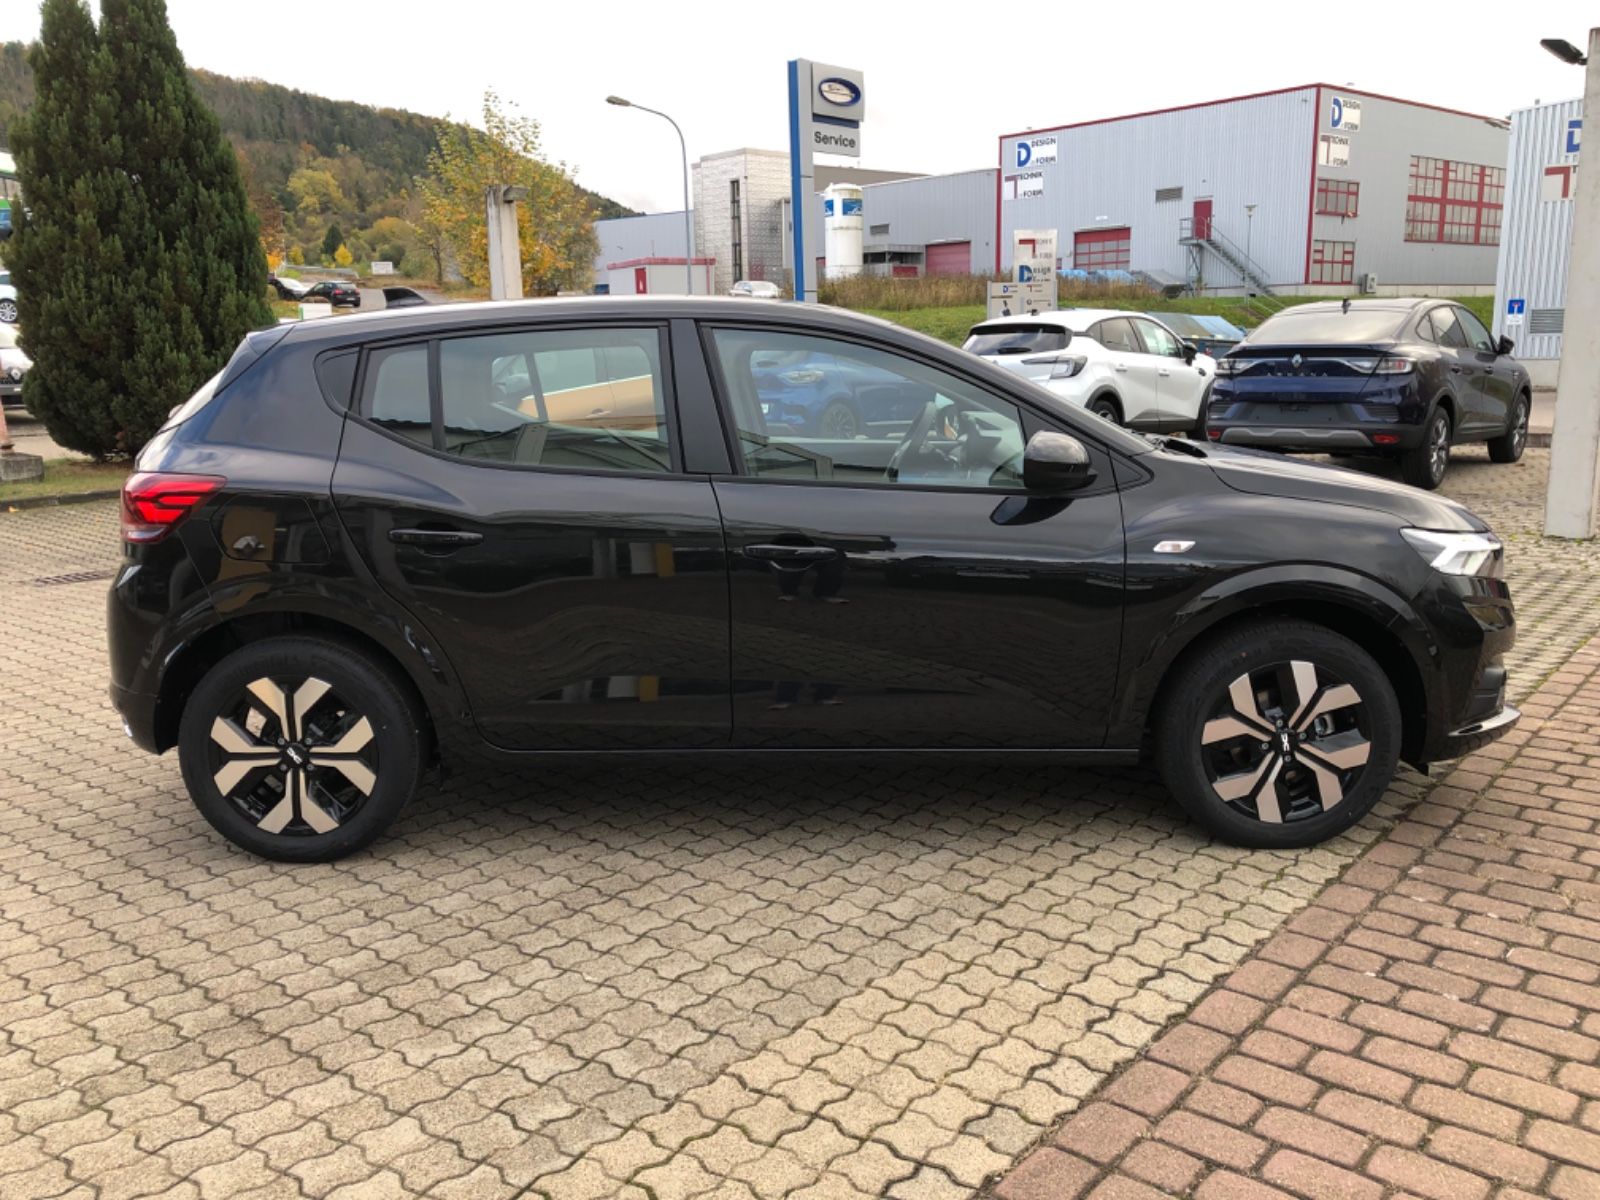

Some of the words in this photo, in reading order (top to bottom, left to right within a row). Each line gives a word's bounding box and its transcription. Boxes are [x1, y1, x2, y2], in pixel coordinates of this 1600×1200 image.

[814, 131, 856, 148] Service
[1031, 137, 1056, 148] DESIGN
[1017, 142, 1032, 168] D
[1036, 156, 1056, 165] FORM
[1023, 189, 1043, 198] FORM
